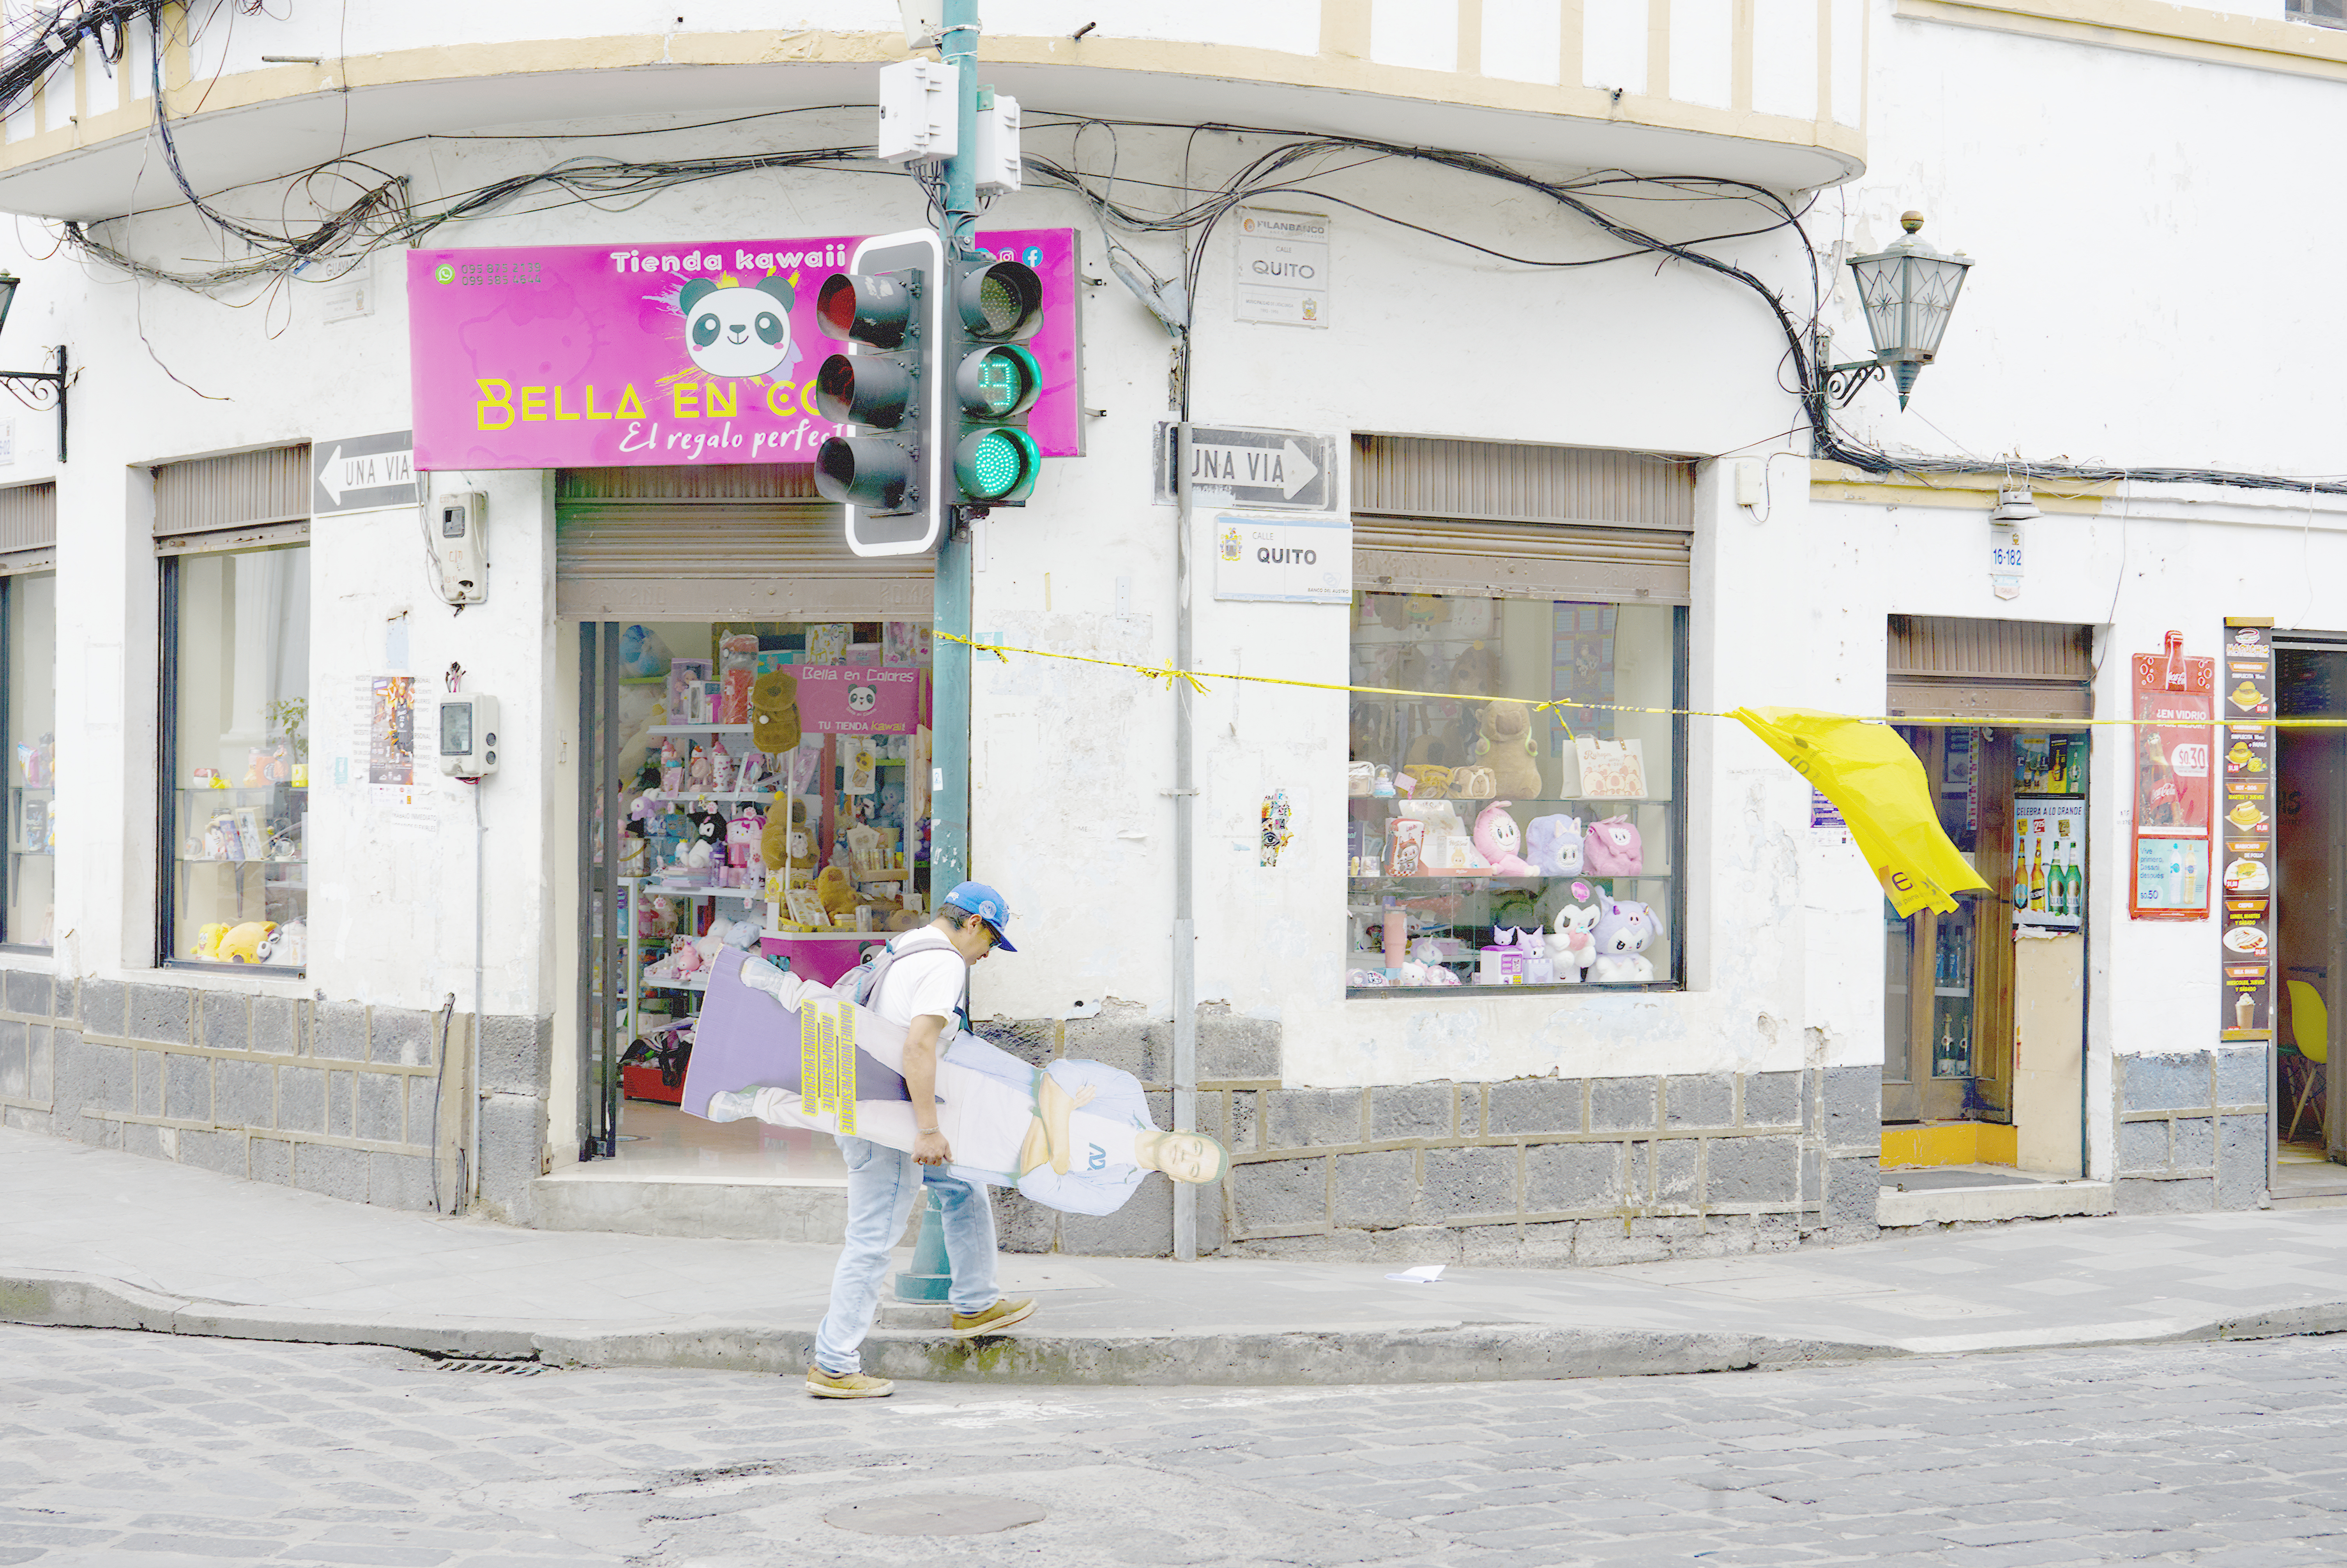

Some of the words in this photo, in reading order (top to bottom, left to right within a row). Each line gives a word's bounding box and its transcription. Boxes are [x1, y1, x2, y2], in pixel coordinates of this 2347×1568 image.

[326, 258, 366, 277] GUAYAQUIL
[610, 249, 723, 274] Tienda
[736, 243, 846, 270] kawaii
[461, 265, 483, 274] 095
[487, 263, 508, 273] 875
[513, 262, 541, 272] 2139
[1252, 260, 1315, 279] QUITO
[462, 276, 483, 285] 099
[488, 275, 508, 284] 585
[513, 275, 541, 284] 4644
[476, 378, 647, 431] BELLA
[674, 381, 737, 418] EN
[619, 421, 656, 453] El
[666, 420, 743, 460] regalo
[346, 460, 376, 486] UNA
[386, 455, 409, 481] VIA
[1247, 452, 1284, 482] VIA
[1252, 531, 1274, 540] CALLE
[1257, 547, 1317, 565] QUITO
[802, 666, 838, 680] Bella
[844, 671, 860, 681] en
[866, 668, 914, 682] Colores
[2156, 709, 2174, 719] ¿EN
[2176, 710, 2207, 720] VIDRIO
[818, 721, 831, 730] TU
[835, 721, 868, 731] TIENDA
[411, 813, 437, 821] INMEDIATO
[2017, 807, 2041, 816] CELEBRA
[2057, 807, 2082, 815] GRANDE
[1903, 894, 1919, 906] para
[804, 1002, 816, 1114] #PORUNNUEVOECUADOR
[822, 1015, 834, 1111] #NOBOAPRESIDENTE
[841, 1003, 854, 1132] #DANIELNOBOAPRESIDENTE
